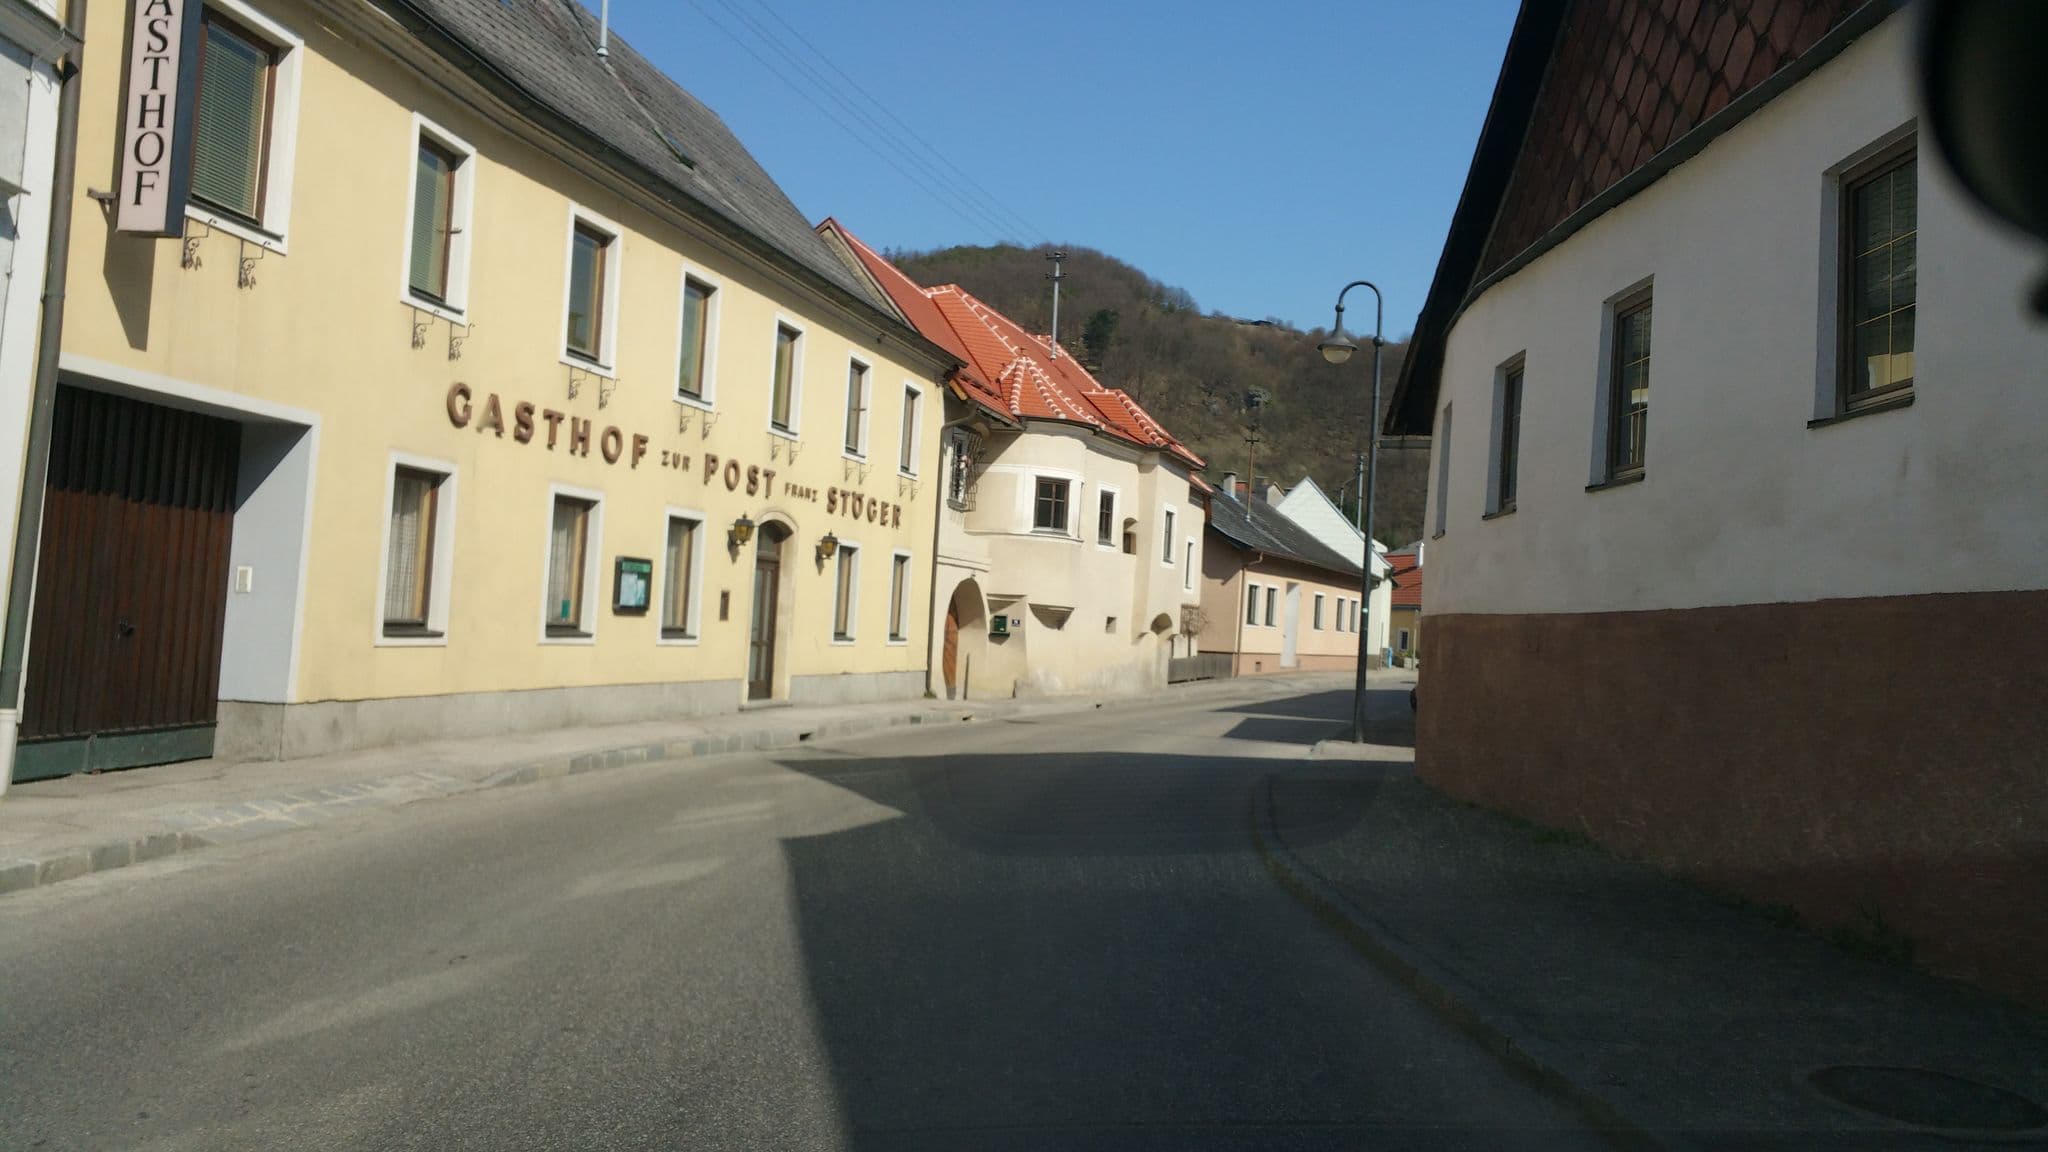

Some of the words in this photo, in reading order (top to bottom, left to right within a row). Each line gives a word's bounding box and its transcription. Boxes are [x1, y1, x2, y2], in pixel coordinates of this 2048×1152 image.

[446, 382, 649, 470] GASTHOF
[661, 450, 690, 472] ZUR
[703, 453, 776, 498] POST
[784, 482, 817, 502] FRANZ
[826, 486, 902, 529] STÖGER
